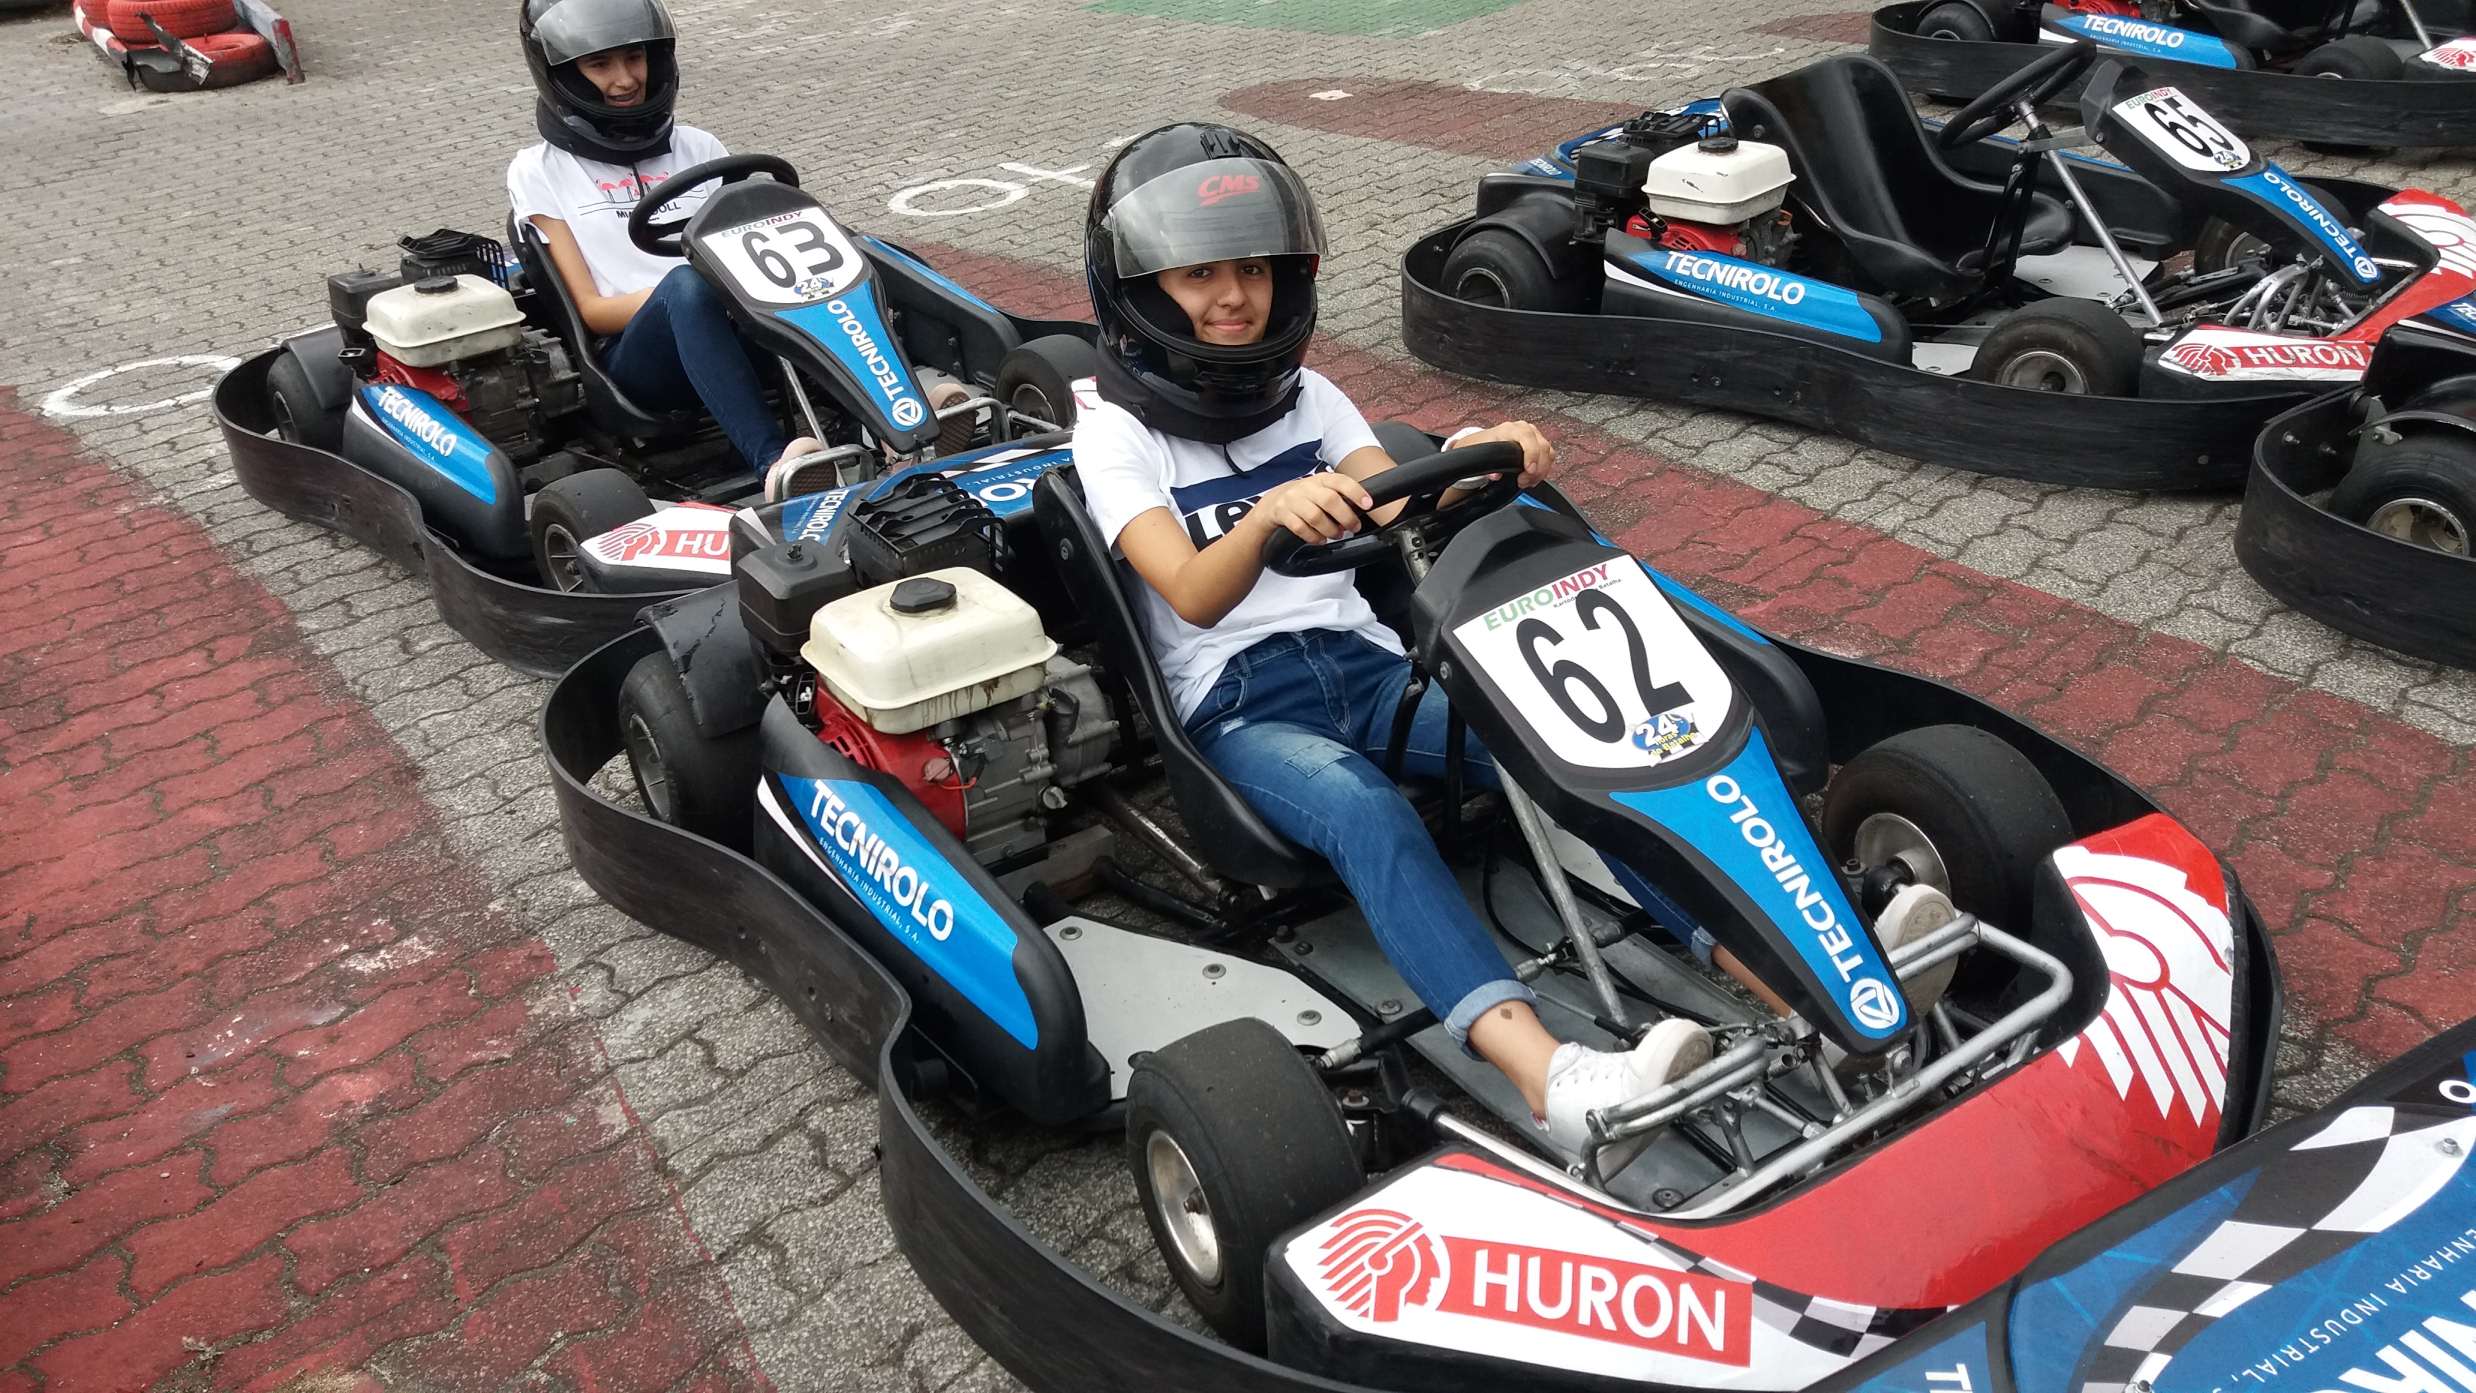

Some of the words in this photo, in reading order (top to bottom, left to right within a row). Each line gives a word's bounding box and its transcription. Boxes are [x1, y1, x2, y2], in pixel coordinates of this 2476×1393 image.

[2083, 14, 2185, 48] TECNIROLO
[2126, 87, 2172, 110] EUROINDY
[2144, 97, 2234, 157] 65
[1198, 174, 1261, 198] CMS
[2264, 172, 2358, 258] TECNIROLO
[721, 211, 802, 238] EUROINDY
[742, 221, 844, 288] 63
[1665, 251, 1805, 305] TECNIROLO
[1674, 278, 1717, 295] ENGENHARIA
[828, 300, 904, 402] TECNIROLO
[2244, 345, 2367, 367] HURON
[379, 386, 457, 457] TECNIROLO
[1483, 563, 1609, 631] EUROINDY
[1516, 588, 1695, 744] 62
[1635, 713, 1679, 748] 24
[810, 779, 954, 942] TECNIROLO
[819, 837, 860, 883] ENGENHARIA
[1706, 774, 1864, 983] TECNIROLO
[1473, 1248, 1726, 1352] HURON
